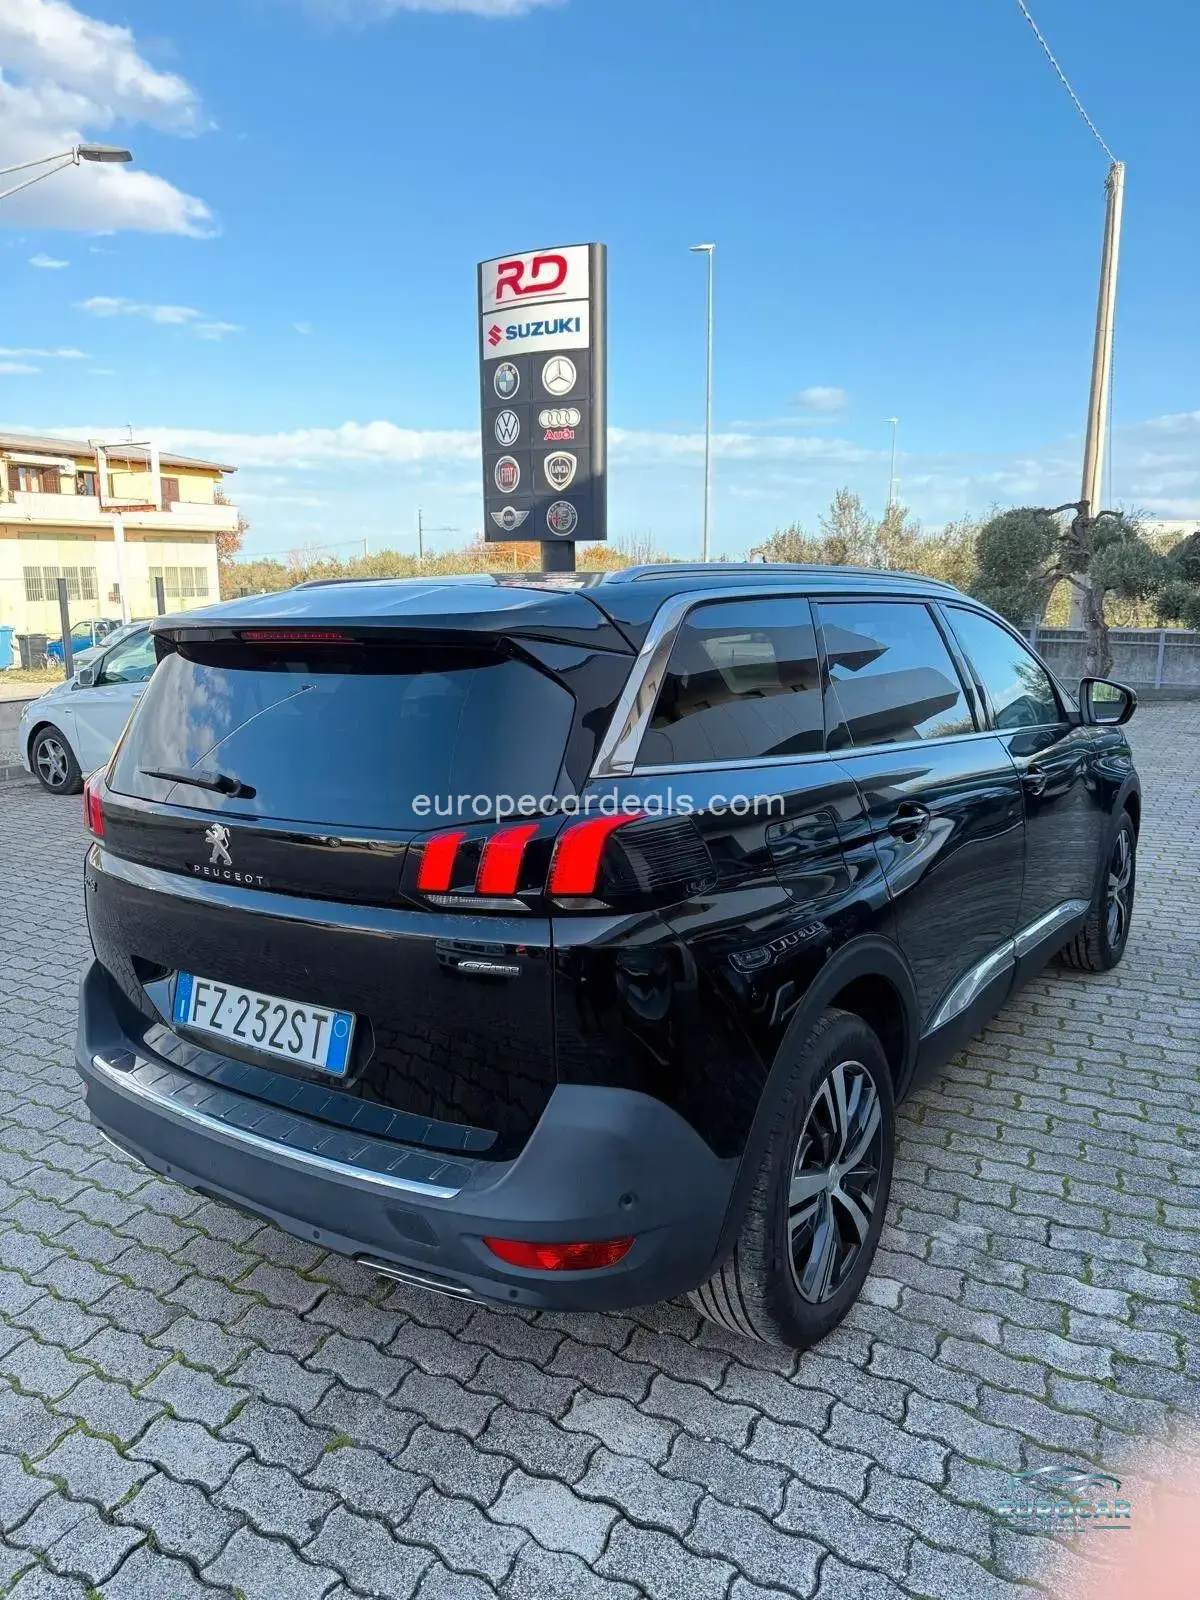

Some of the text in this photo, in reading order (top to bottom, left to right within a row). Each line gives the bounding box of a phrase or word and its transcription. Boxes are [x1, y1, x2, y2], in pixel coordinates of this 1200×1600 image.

[496, 254, 568, 300] RD
[505, 317, 581, 341] SUZUKI
[543, 428, 575, 441] Audi
[194, 864, 264, 885] PEUGEOT
